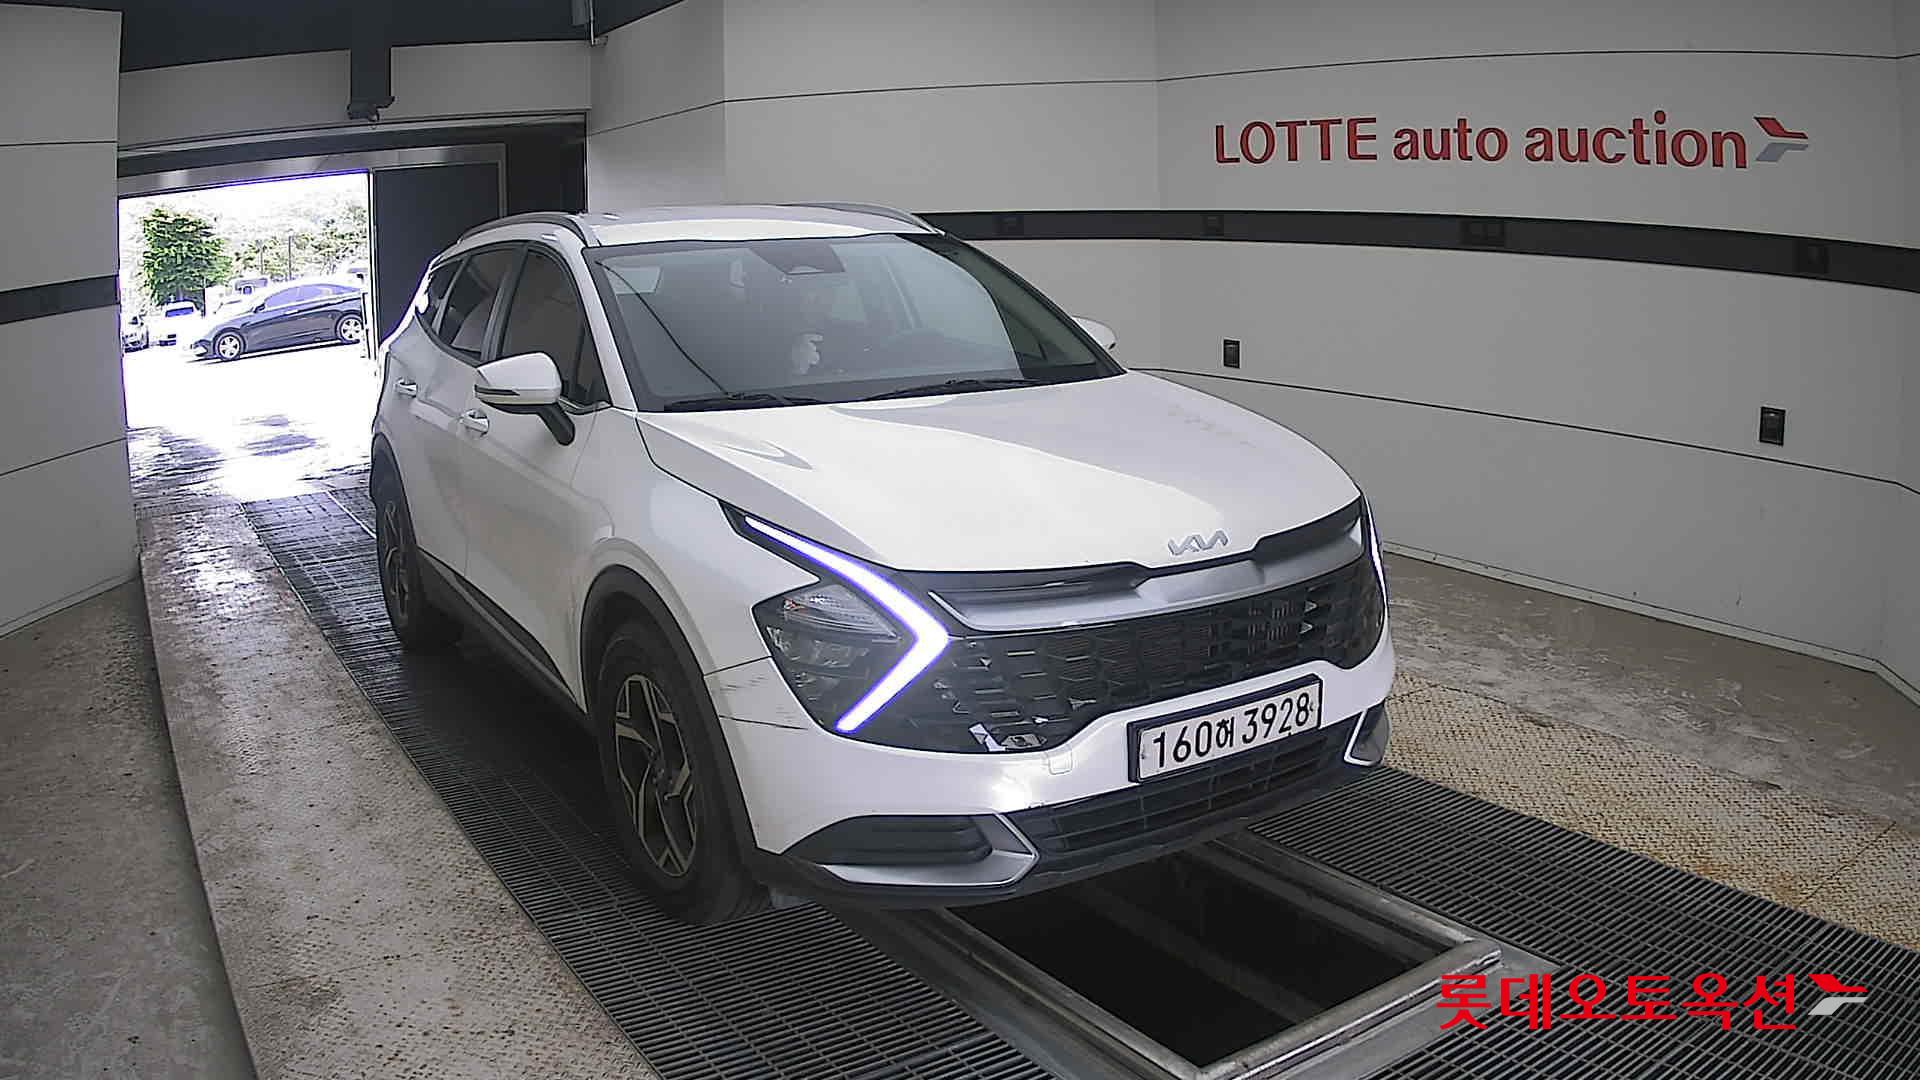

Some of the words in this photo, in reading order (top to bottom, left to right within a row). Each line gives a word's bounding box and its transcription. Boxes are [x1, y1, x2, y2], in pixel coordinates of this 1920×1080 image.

[1215, 116, 1378, 165] LOTTE
[1393, 117, 1509, 162] auto
[1524, 109, 1748, 169] auction
[1153, 716, 1235, 768] 160허
[1242, 692, 1310, 745] 3928
